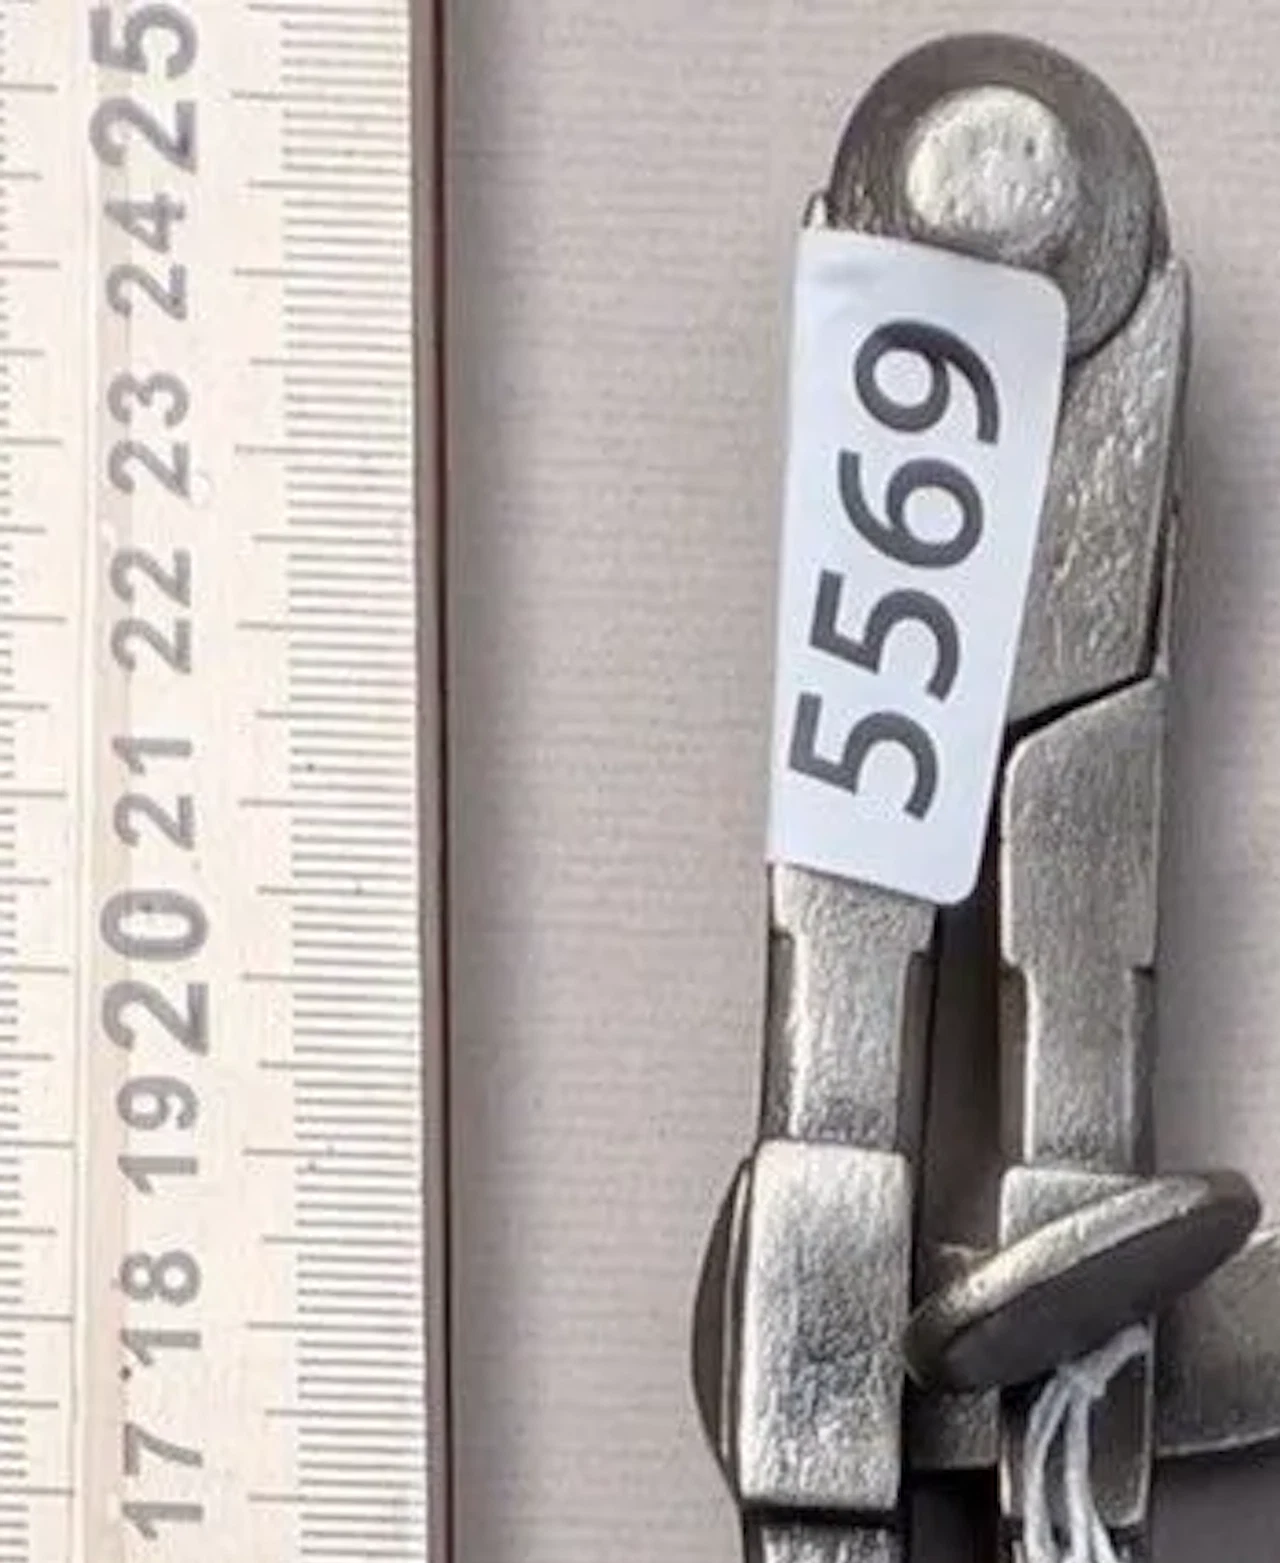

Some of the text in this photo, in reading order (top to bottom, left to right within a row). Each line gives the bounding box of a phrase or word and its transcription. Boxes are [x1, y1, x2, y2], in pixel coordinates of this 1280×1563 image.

[89, 0, 200, 174] 25
[103, 192, 187, 321] 24
[108, 371, 190, 499] 23
[110, 547, 191, 675] 22
[787, 318, 1001, 821] 5569
[113, 735, 194, 851] 21
[100, 888, 210, 1057] 20
[117, 1076, 200, 1195] 19
[120, 1251, 203, 1368] 18
[122, 1423, 204, 1541] 17
